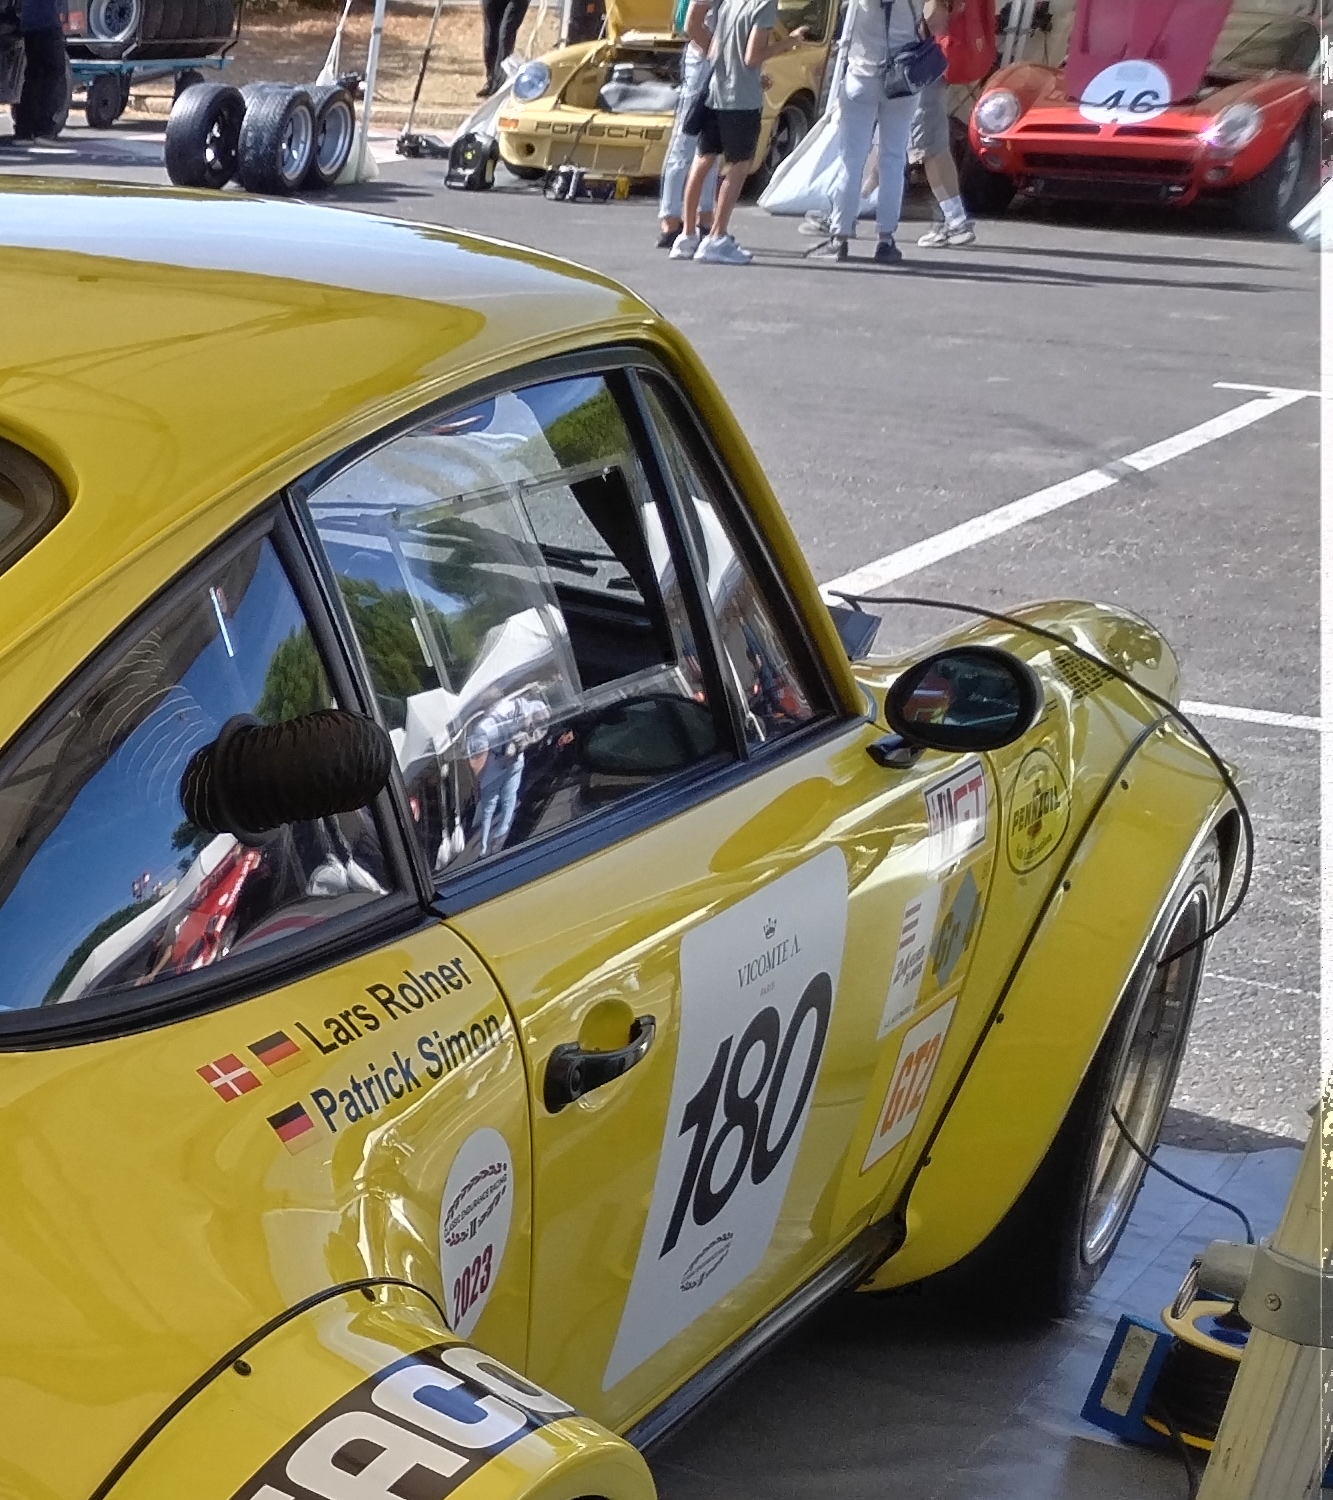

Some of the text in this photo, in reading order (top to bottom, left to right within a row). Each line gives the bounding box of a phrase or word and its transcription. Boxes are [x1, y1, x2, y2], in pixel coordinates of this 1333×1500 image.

[293, 956, 473, 1056] Lars Rolner
[737, 938, 789, 989] VICOMTE
[309, 1013, 506, 1134] Patrick Simon
[658, 971, 833, 1261] 180
[879, 1031, 942, 1138] GT2
[452, 1243, 494, 1332] 2023
